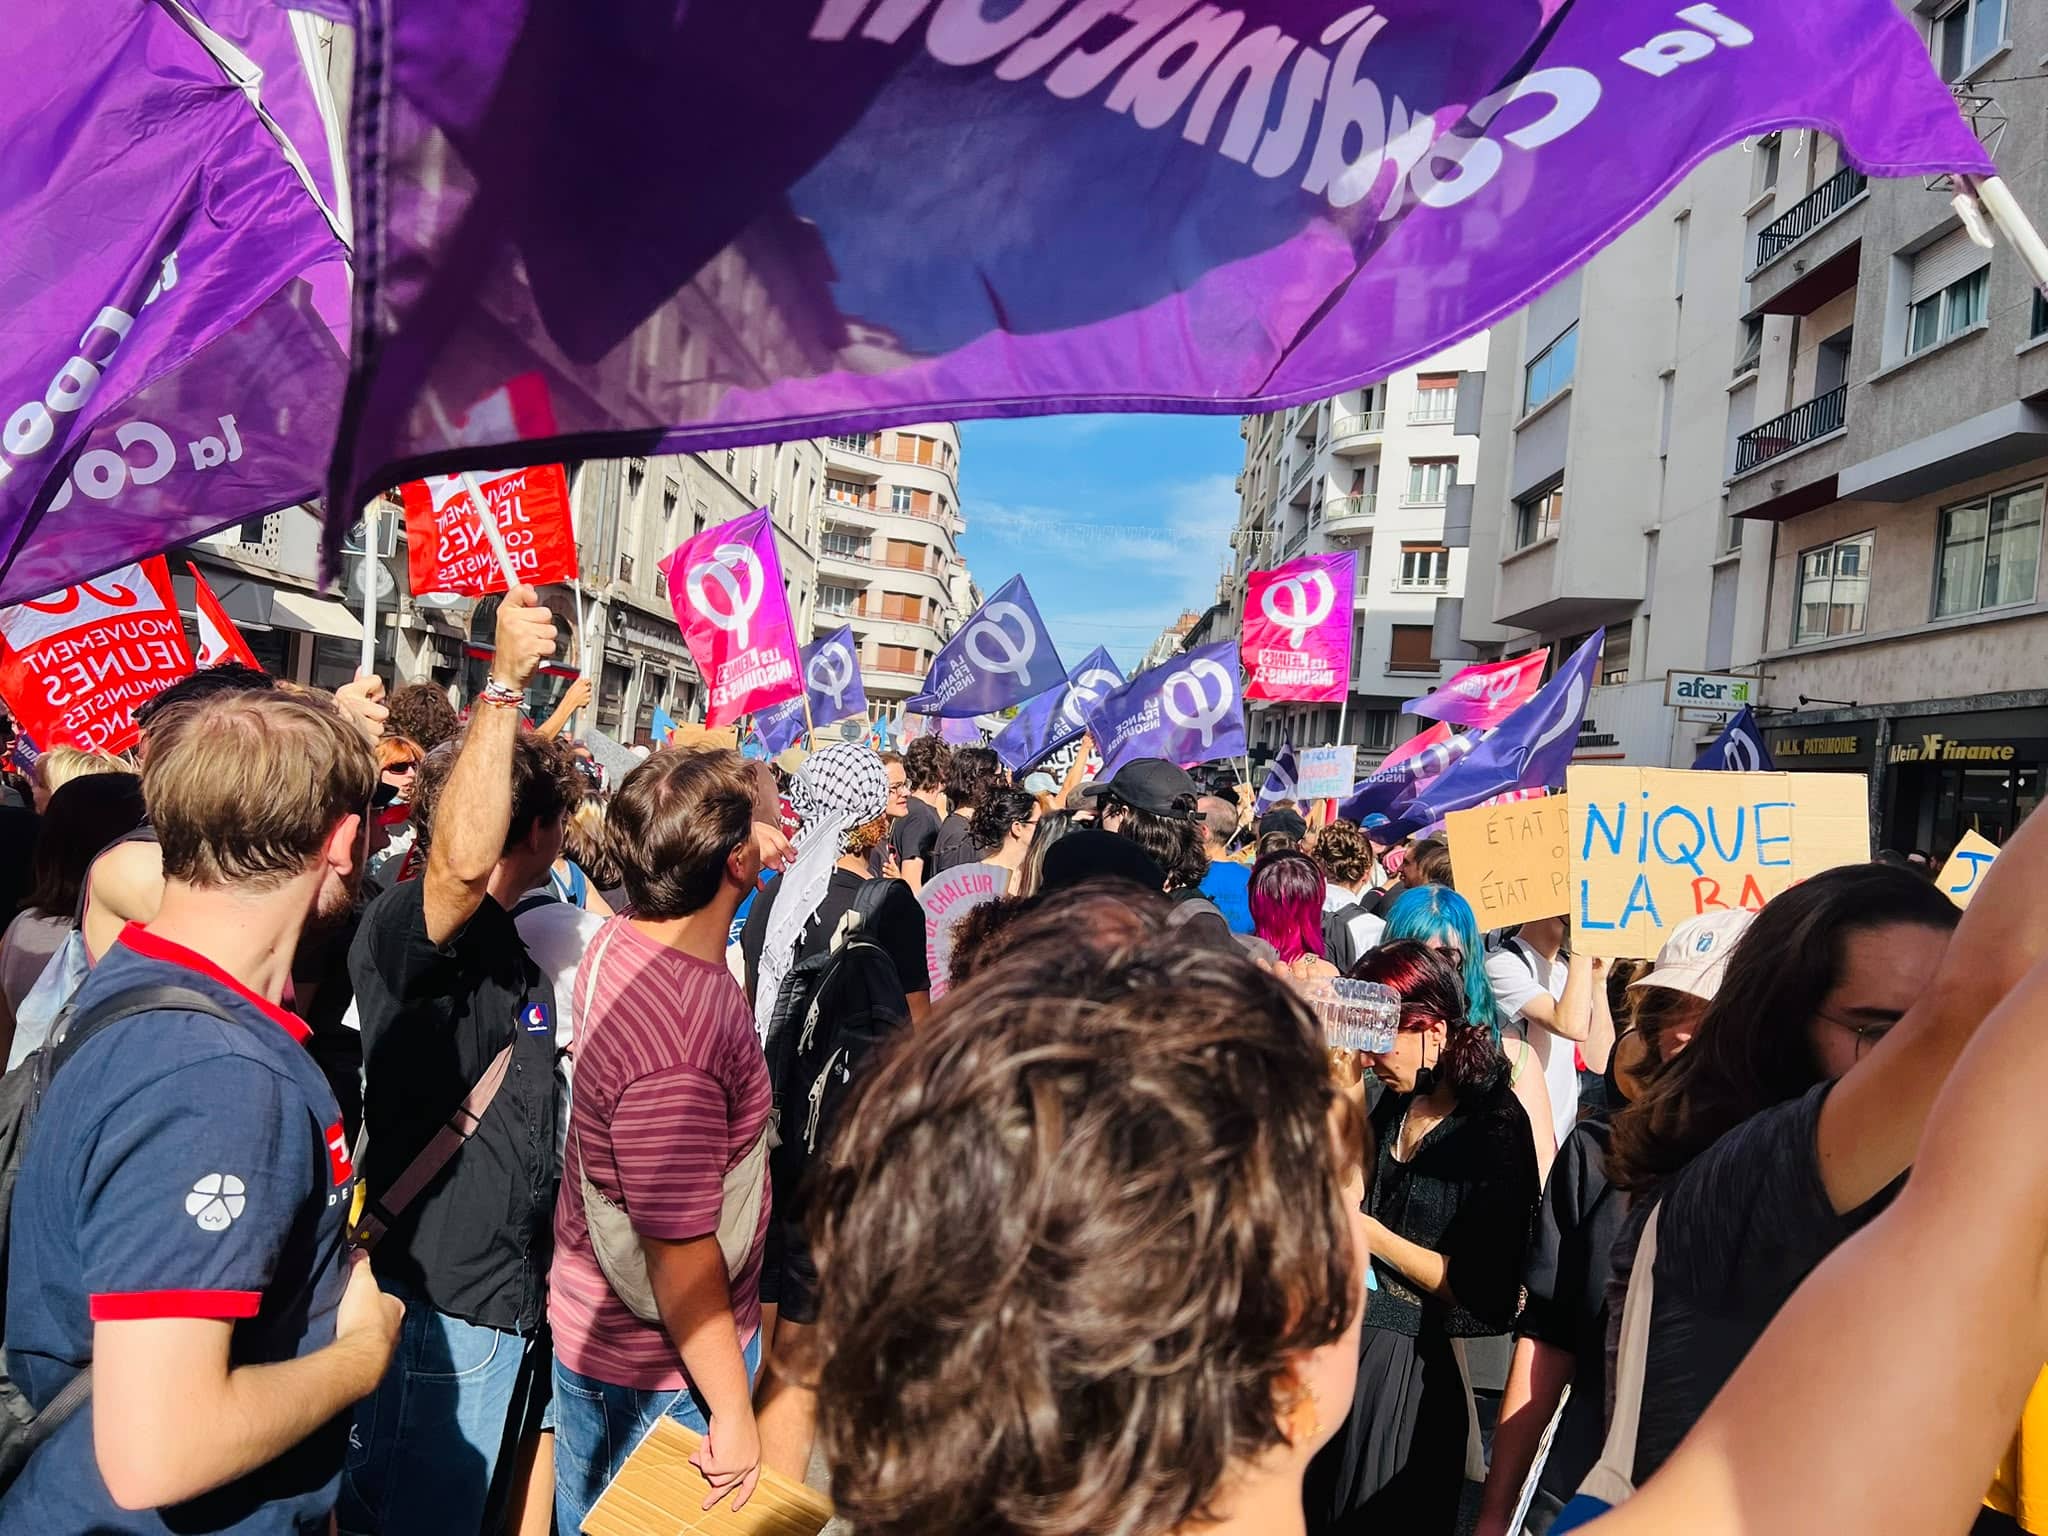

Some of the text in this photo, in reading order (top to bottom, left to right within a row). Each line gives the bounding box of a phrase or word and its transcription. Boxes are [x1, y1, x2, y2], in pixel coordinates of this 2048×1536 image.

[1677, 677, 1727, 699] afer
[1803, 736, 1857, 754] PATRIMOINE
[1890, 744, 1919, 763] klein
[1943, 740, 2015, 760] finance
[1486, 811, 1544, 845] ÉTAT
[926, 874, 993, 915] CHALEUR
[1480, 870, 1528, 911] ÉTAT
[1581, 873, 1663, 929] LA
